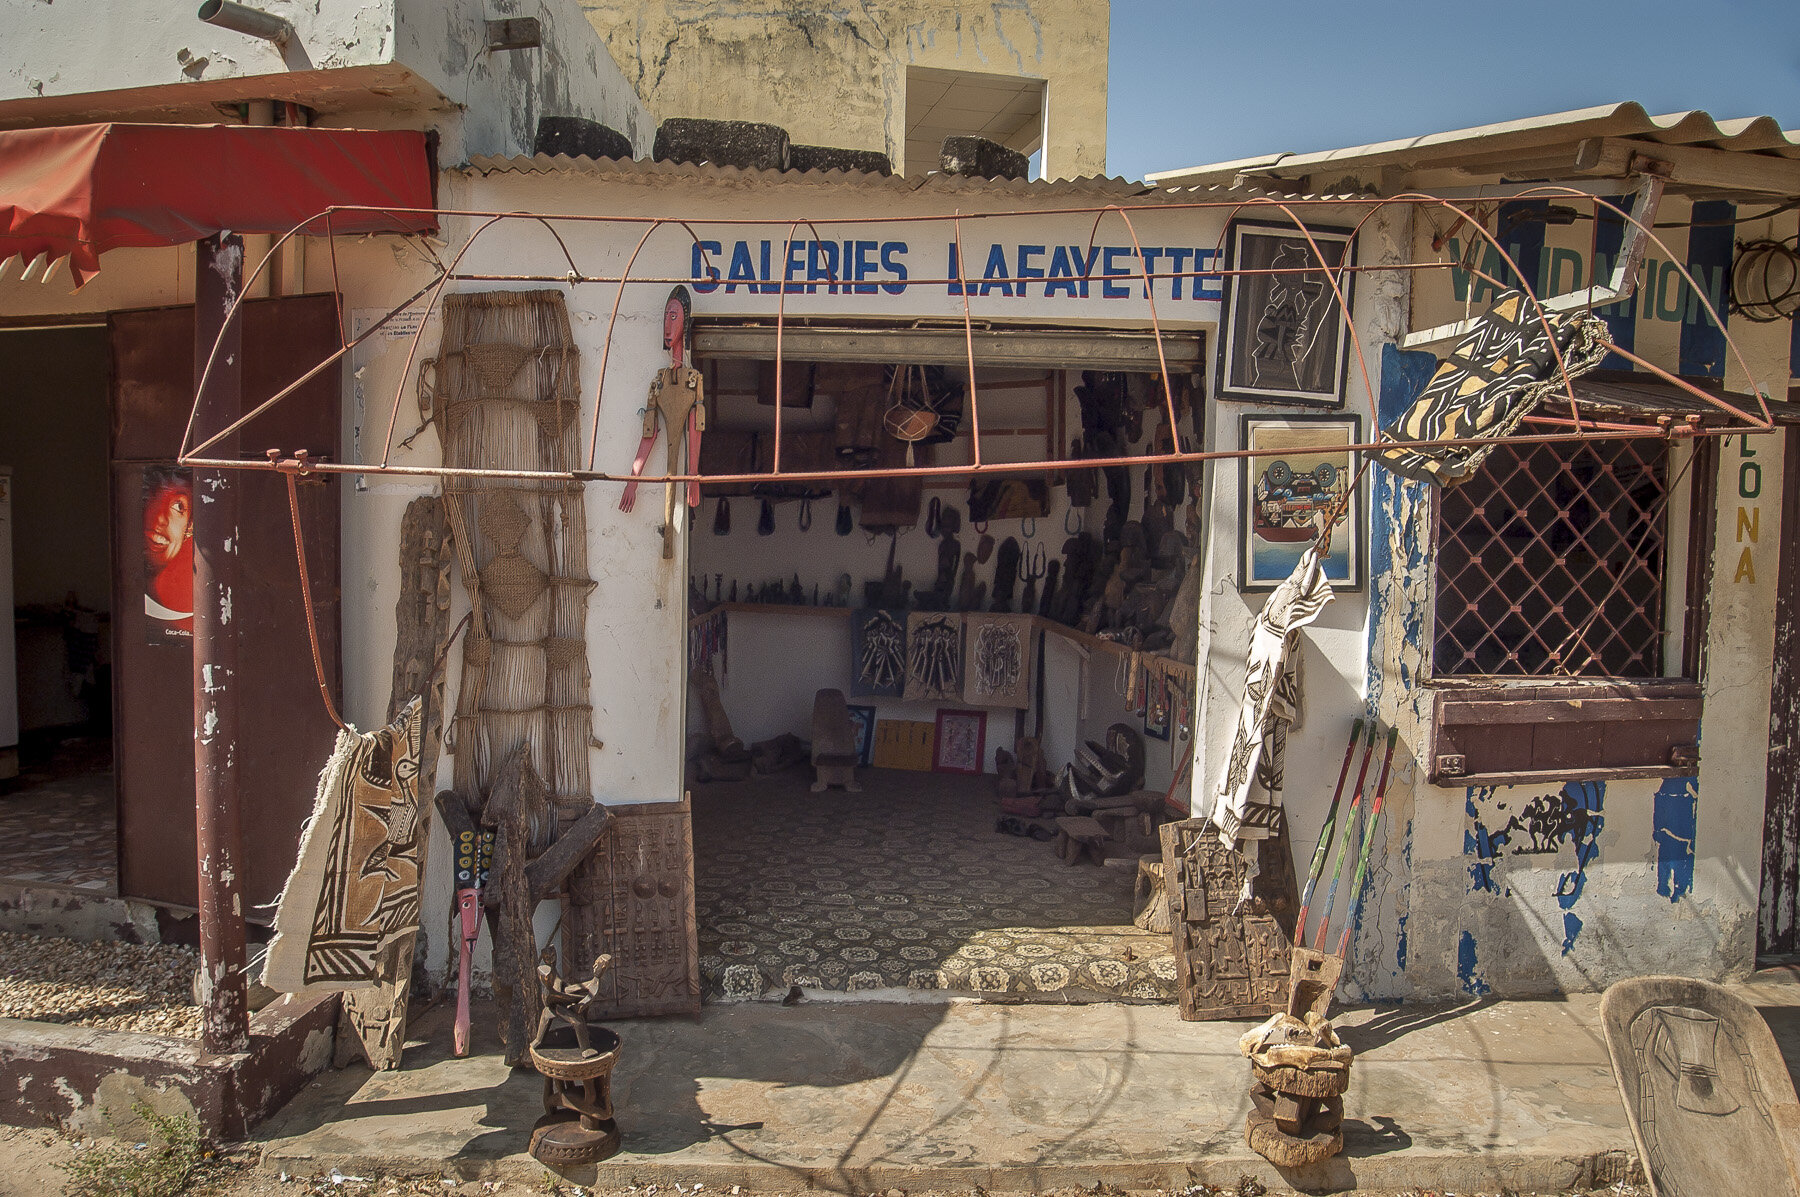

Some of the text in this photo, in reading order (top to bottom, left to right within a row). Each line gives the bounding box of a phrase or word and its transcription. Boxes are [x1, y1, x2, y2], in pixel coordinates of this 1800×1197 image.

[691, 239, 1222, 302] GALERIES LAFAYETTE
[165, 628, 191, 636] Coca-Cola
